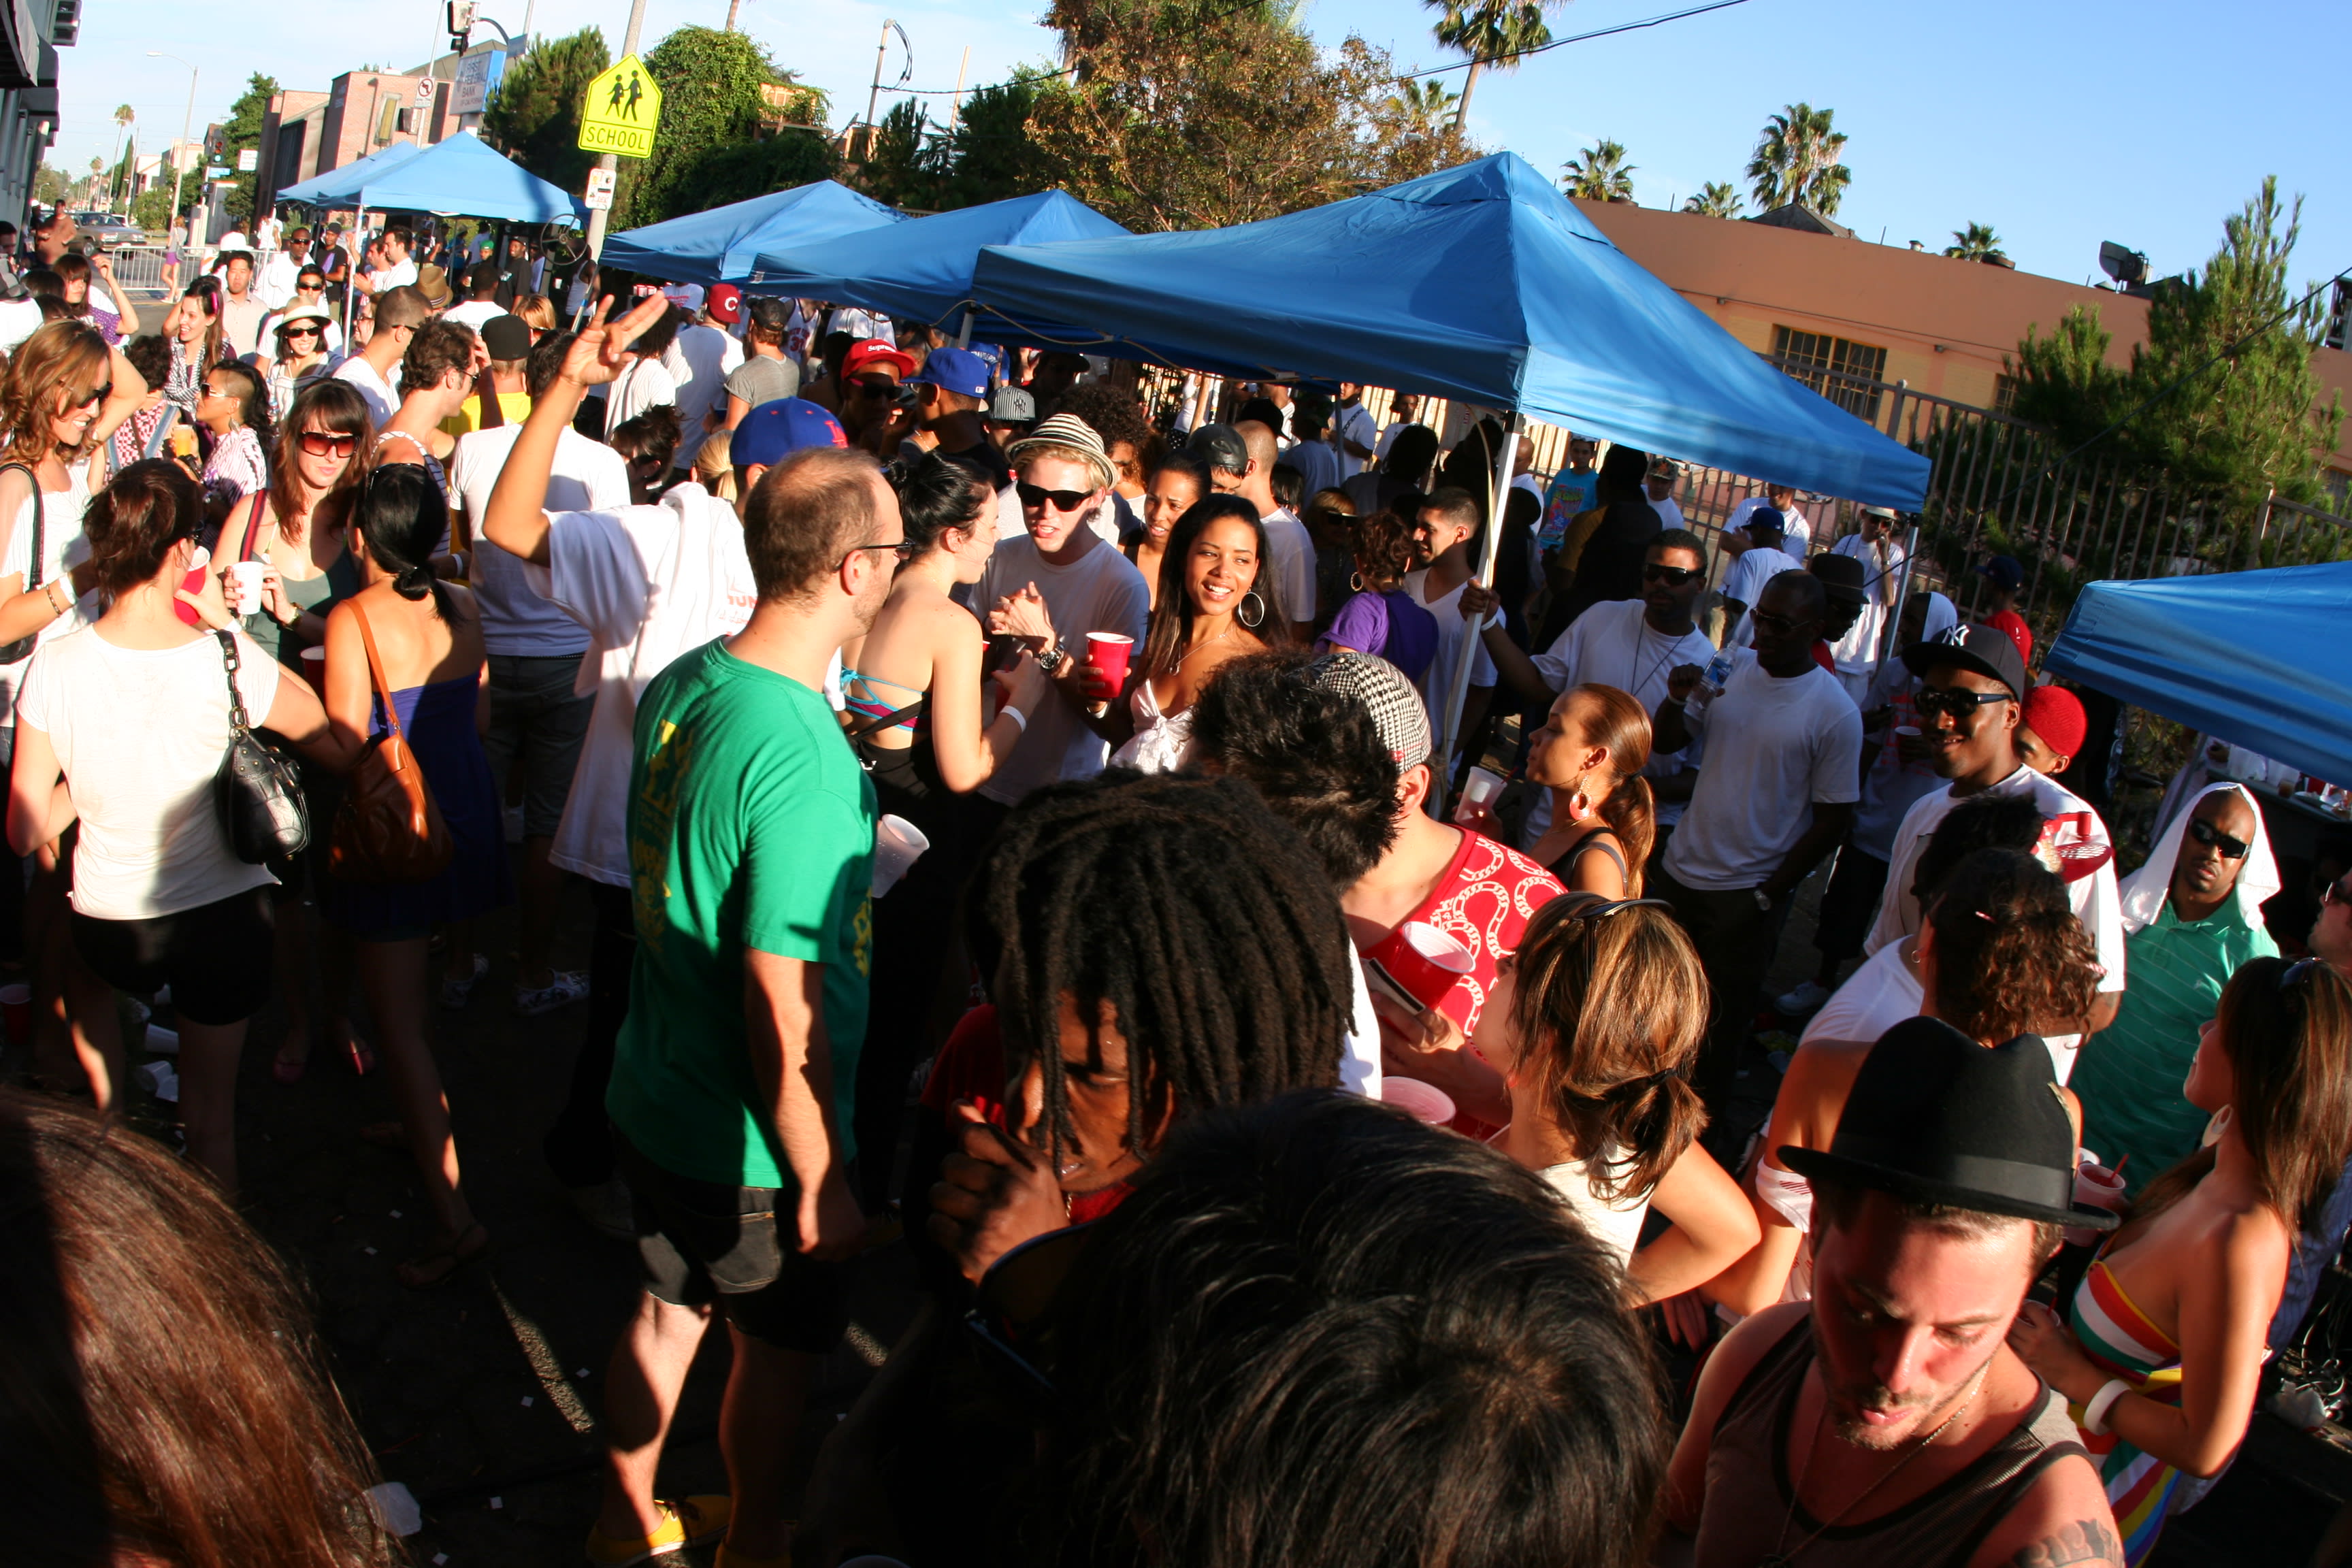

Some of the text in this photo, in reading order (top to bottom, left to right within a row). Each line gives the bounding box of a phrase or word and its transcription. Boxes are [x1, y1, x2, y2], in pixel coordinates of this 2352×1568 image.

[587, 127, 644, 149] SCHOOL
[725, 297, 738, 311] C
[1942, 624, 1970, 646] NY
